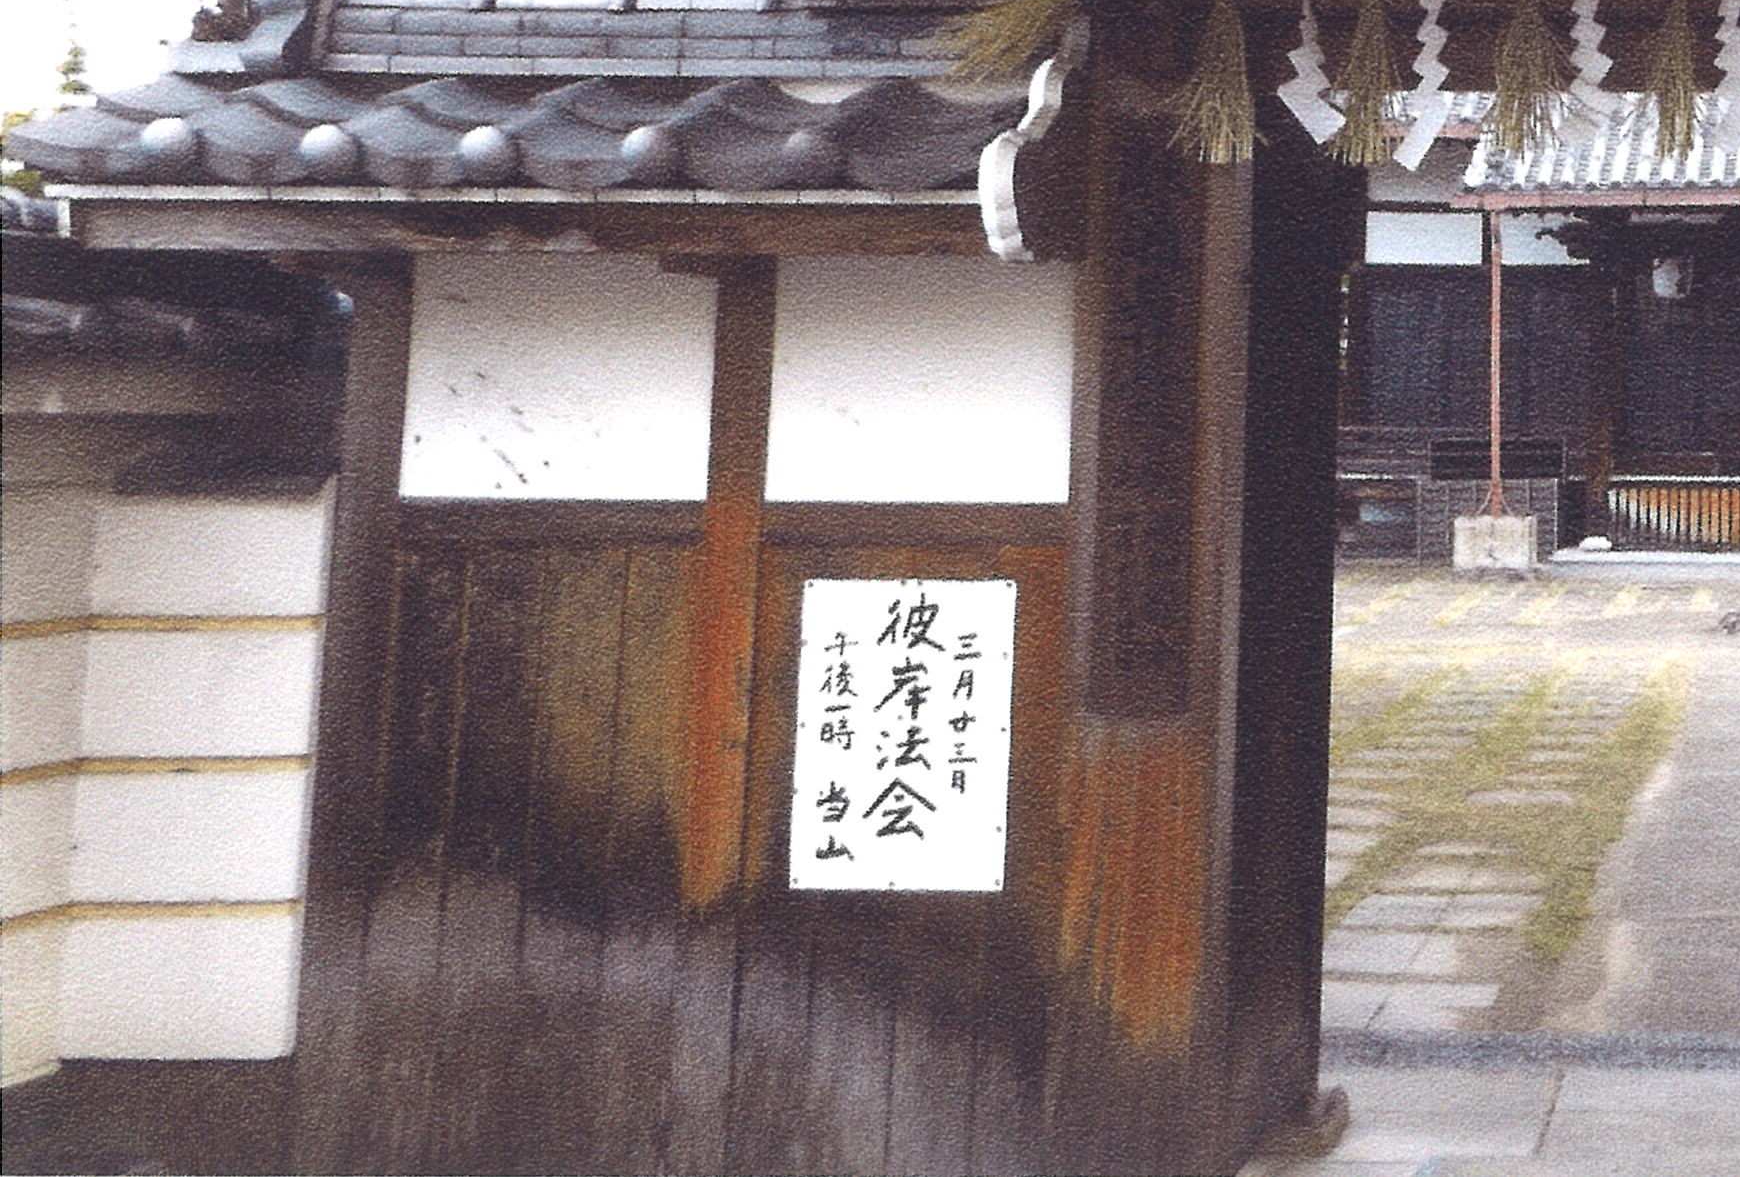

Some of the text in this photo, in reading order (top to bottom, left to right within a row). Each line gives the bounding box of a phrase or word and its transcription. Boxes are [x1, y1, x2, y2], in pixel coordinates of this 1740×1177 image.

[816, 631, 859, 861] 午後一時 当山
[861, 592, 946, 840] 彼岸法会
